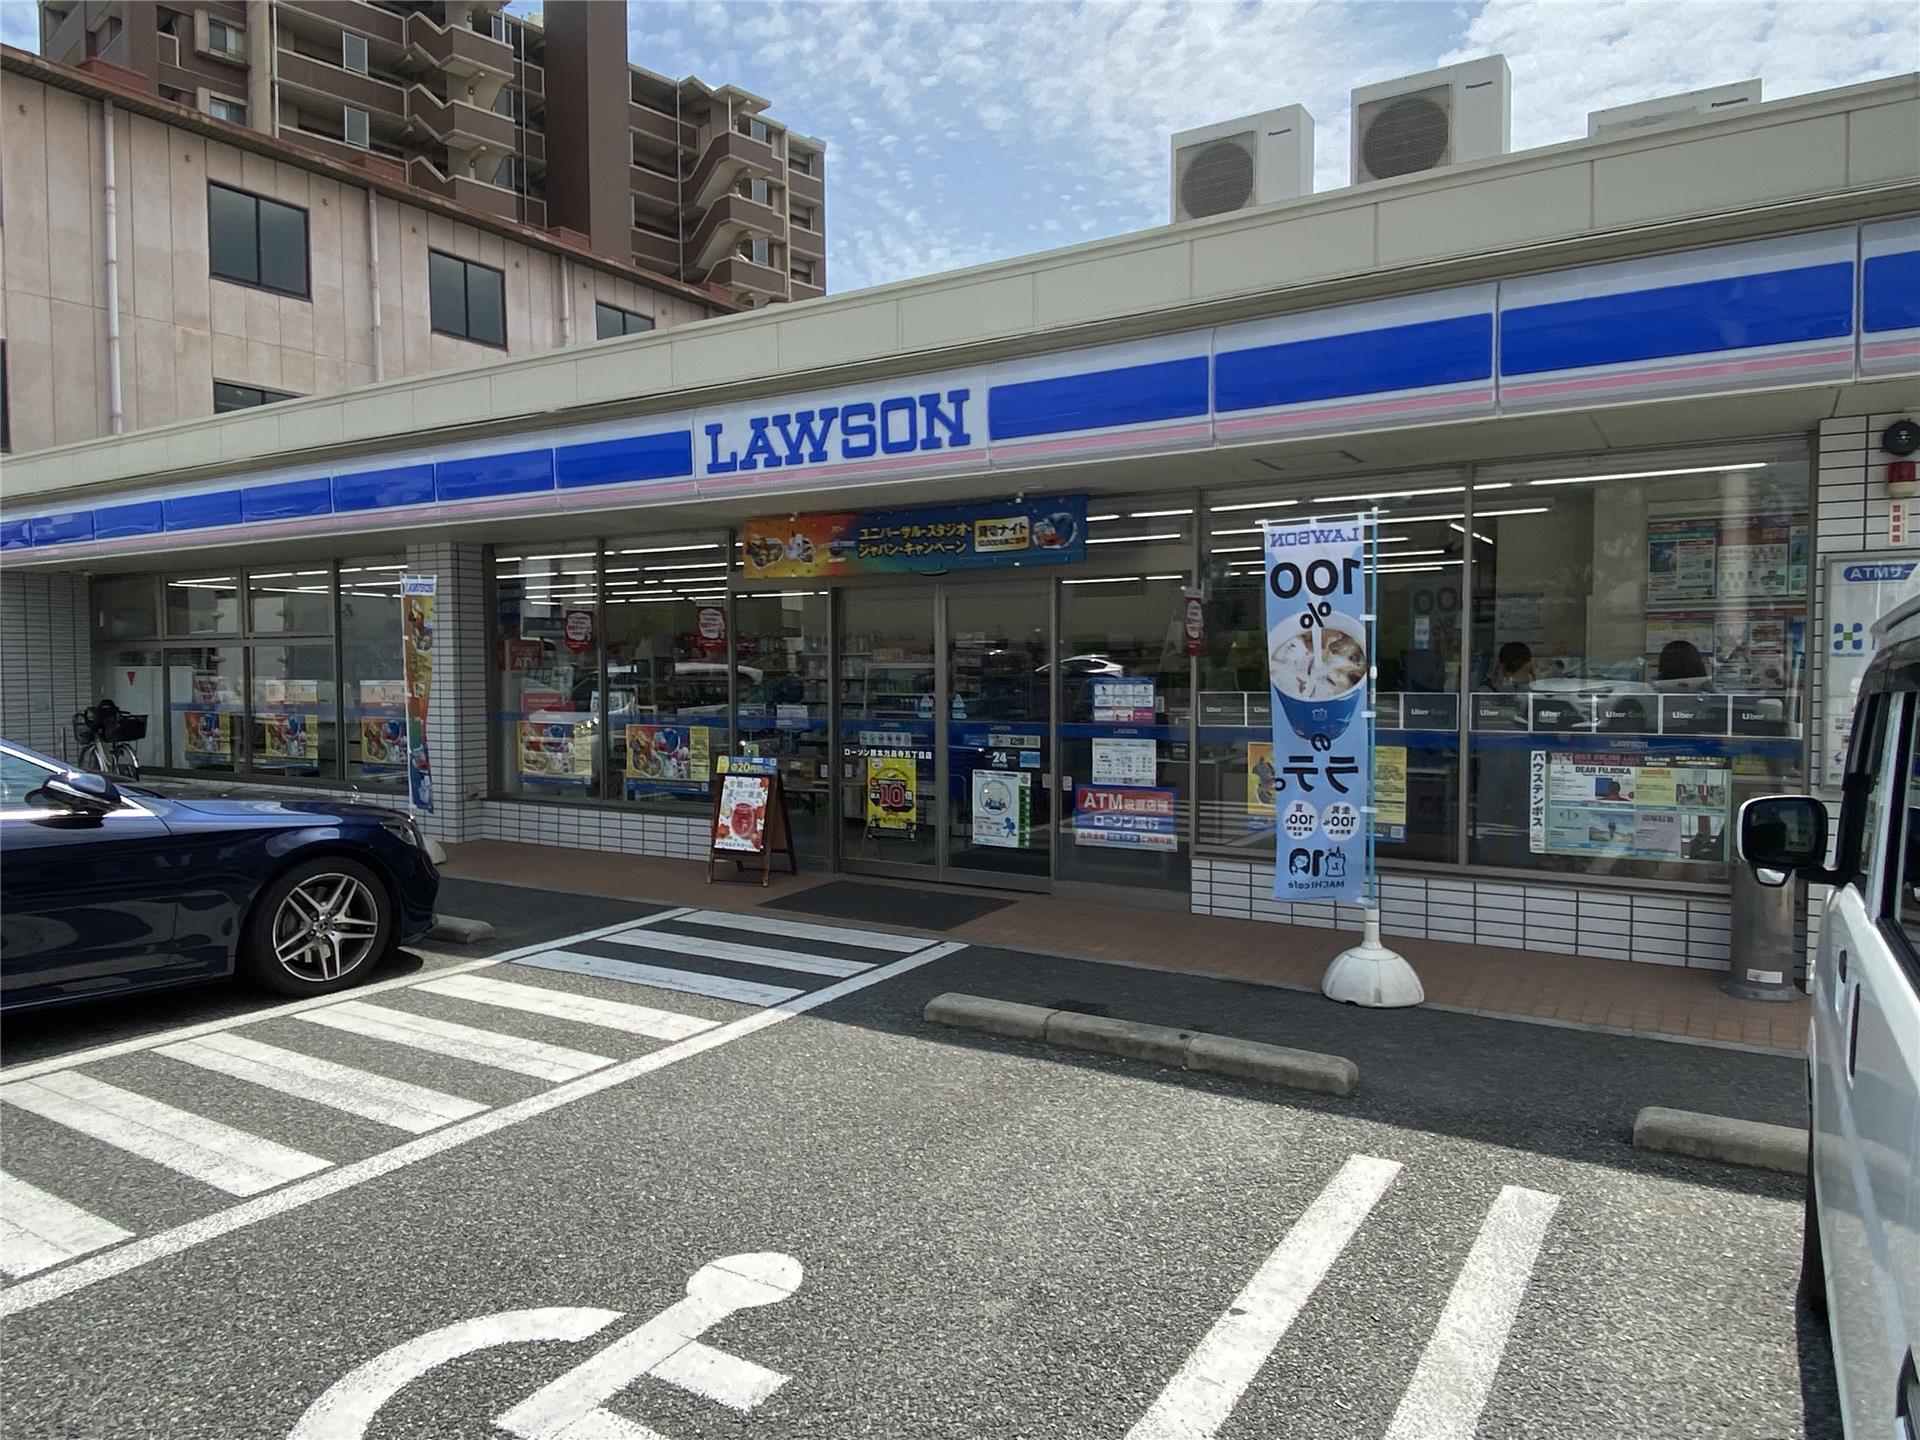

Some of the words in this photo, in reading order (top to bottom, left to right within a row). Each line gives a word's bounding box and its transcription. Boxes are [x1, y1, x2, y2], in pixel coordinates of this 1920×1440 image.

[705, 388, 971, 473] LAWSON
[992, 752, 1007, 763] 24
[1532, 753, 1545, 827] ハウステンボス
